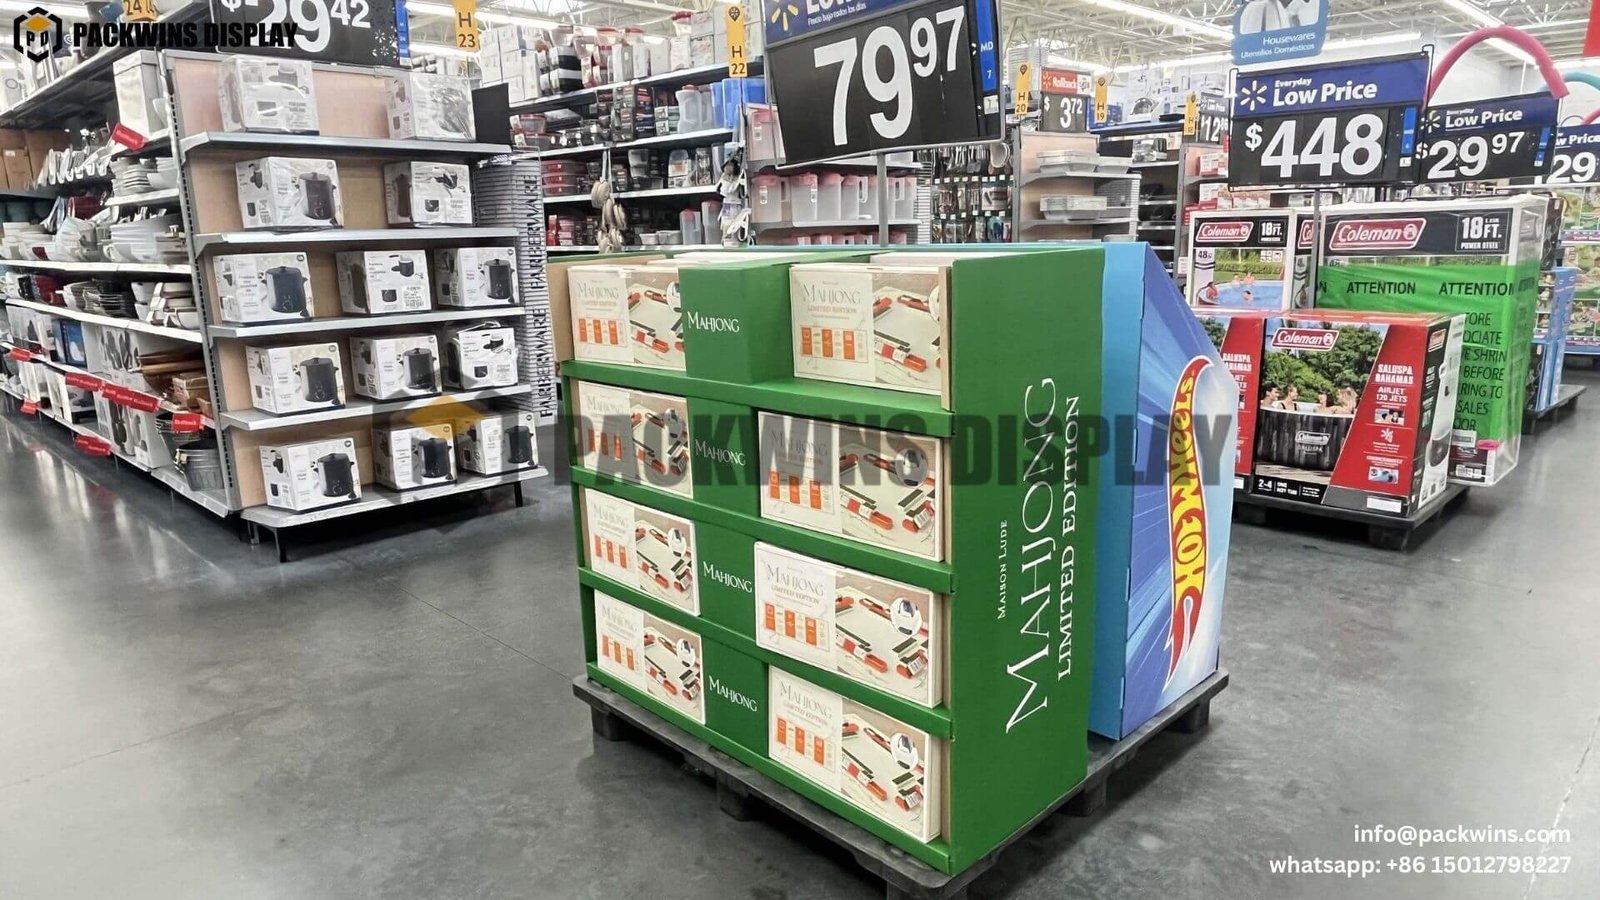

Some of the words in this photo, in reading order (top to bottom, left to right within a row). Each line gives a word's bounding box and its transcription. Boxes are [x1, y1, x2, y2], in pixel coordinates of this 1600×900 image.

[458, 11, 472, 28] H
[458, 33, 476, 48] 23
[1262, 31, 1316, 46] Housewares
[732, 45, 743, 58] H
[980, 41, 994, 52] MD
[731, 62, 746, 75] 22
[986, 69, 992, 79] 7
[1274, 77, 1313, 88] Everyday
[1018, 91, 1026, 101] H
[1273, 88, 1318, 107] Low
[1320, 79, 1378, 103] Price
[1015, 102, 1026, 113] 20
[1097, 102, 1105, 111] H
[1096, 112, 1105, 121] 19
[1445, 115, 1479, 129] Low
[1481, 108, 1523, 125] Price
[1492, 131, 1525, 155] 97
[1546, 151, 1597, 184] 29
[1201, 224, 1240, 237] Coleman
[1338, 224, 1402, 242] Coleman
[803, 282, 862, 305] MAHJONG
[1346, 281, 1416, 295] ATTENTION
[687, 310, 740, 333] MAHJONG
[1276, 330, 1323, 346] Coleman
[1378, 363, 1414, 376] SALUSPA
[1463, 366, 1505, 381] BEFORE
[1374, 373, 1414, 385] BAHAMAS
[1389, 395, 1408, 403] JETS
[1457, 400, 1489, 415] SALES
[695, 439, 746, 467] MAHJONG
[1063, 395, 1080, 533] EDITION
[999, 520, 1009, 557] LUDE
[1005, 376, 1056, 734] MAHJONG
[703, 560, 753, 593] MAHJONG
[766, 563, 824, 597] MAHJONG
[998, 560, 1008, 620] MAISON
[1057, 544, 1076, 683] LIMITED
[708, 675, 758, 713] MAHJONG
